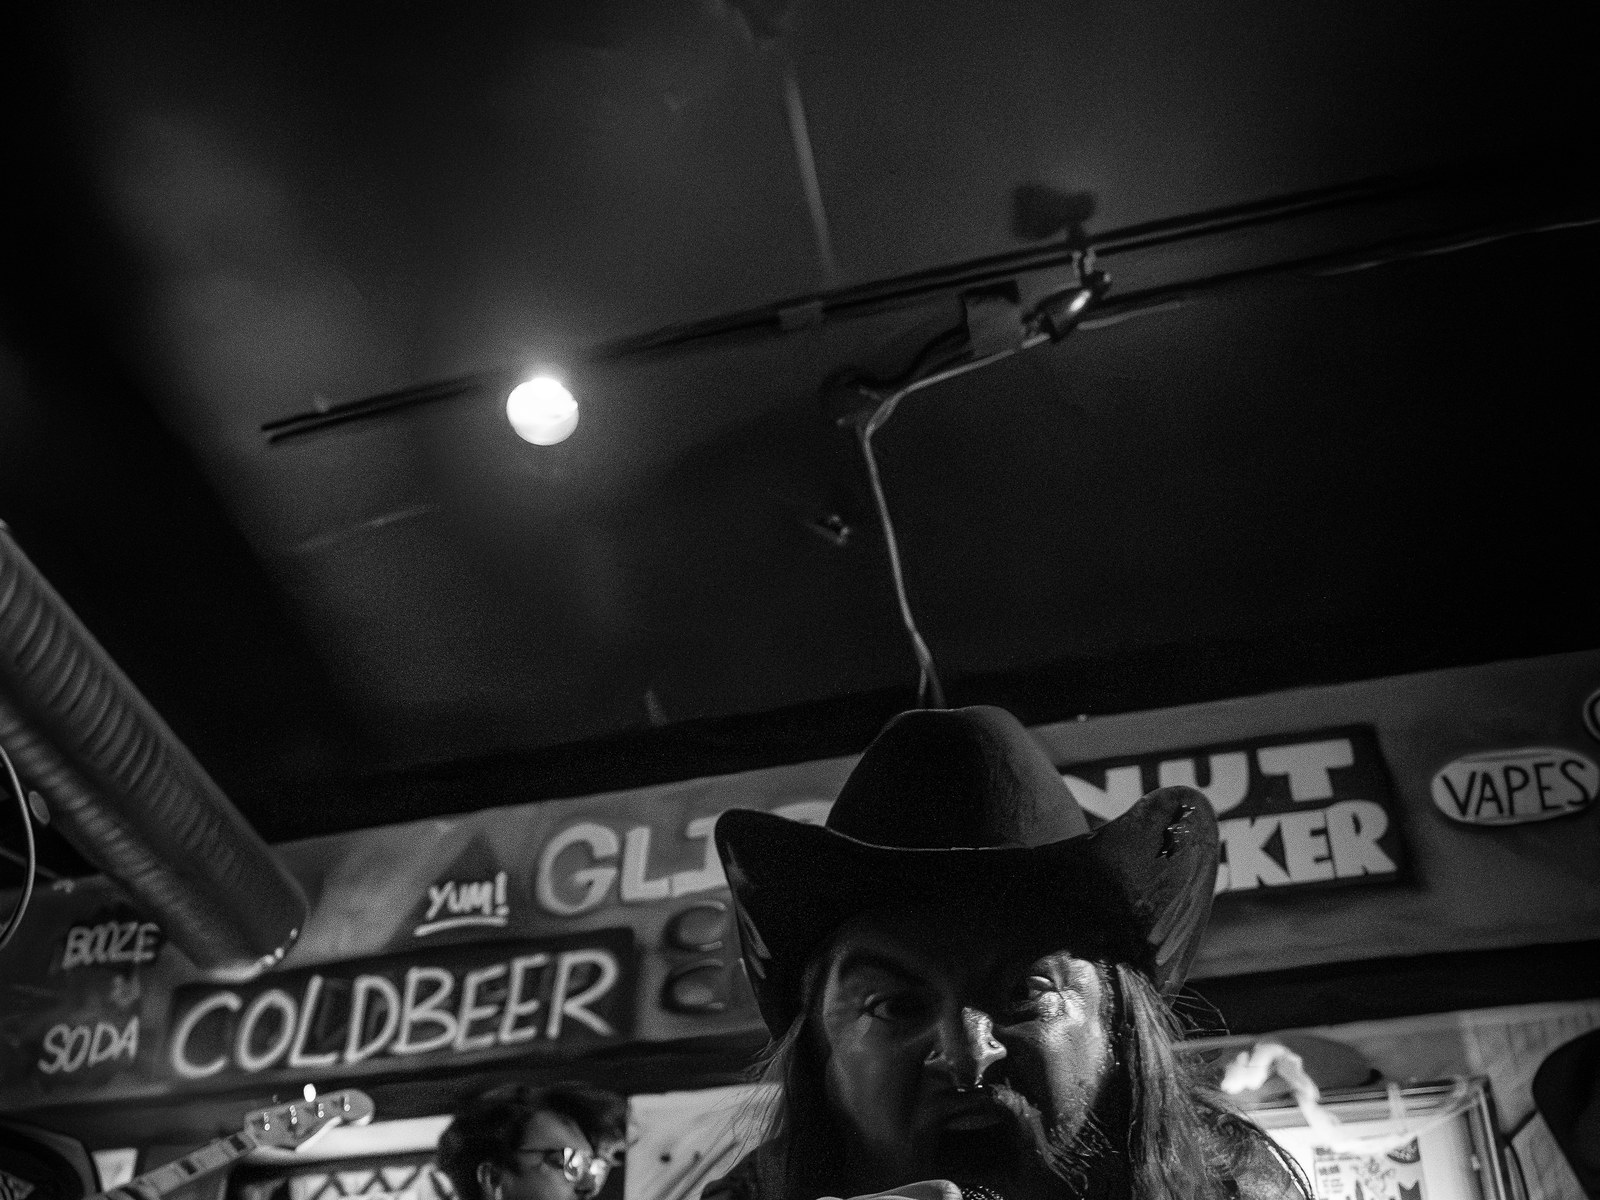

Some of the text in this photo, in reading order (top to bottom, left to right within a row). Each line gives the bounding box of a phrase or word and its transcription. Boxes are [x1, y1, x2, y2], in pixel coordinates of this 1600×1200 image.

[1441, 759, 1590, 816] VAPES
[62, 920, 161, 969] BOOZE
[38, 1016, 140, 1075] SODA
